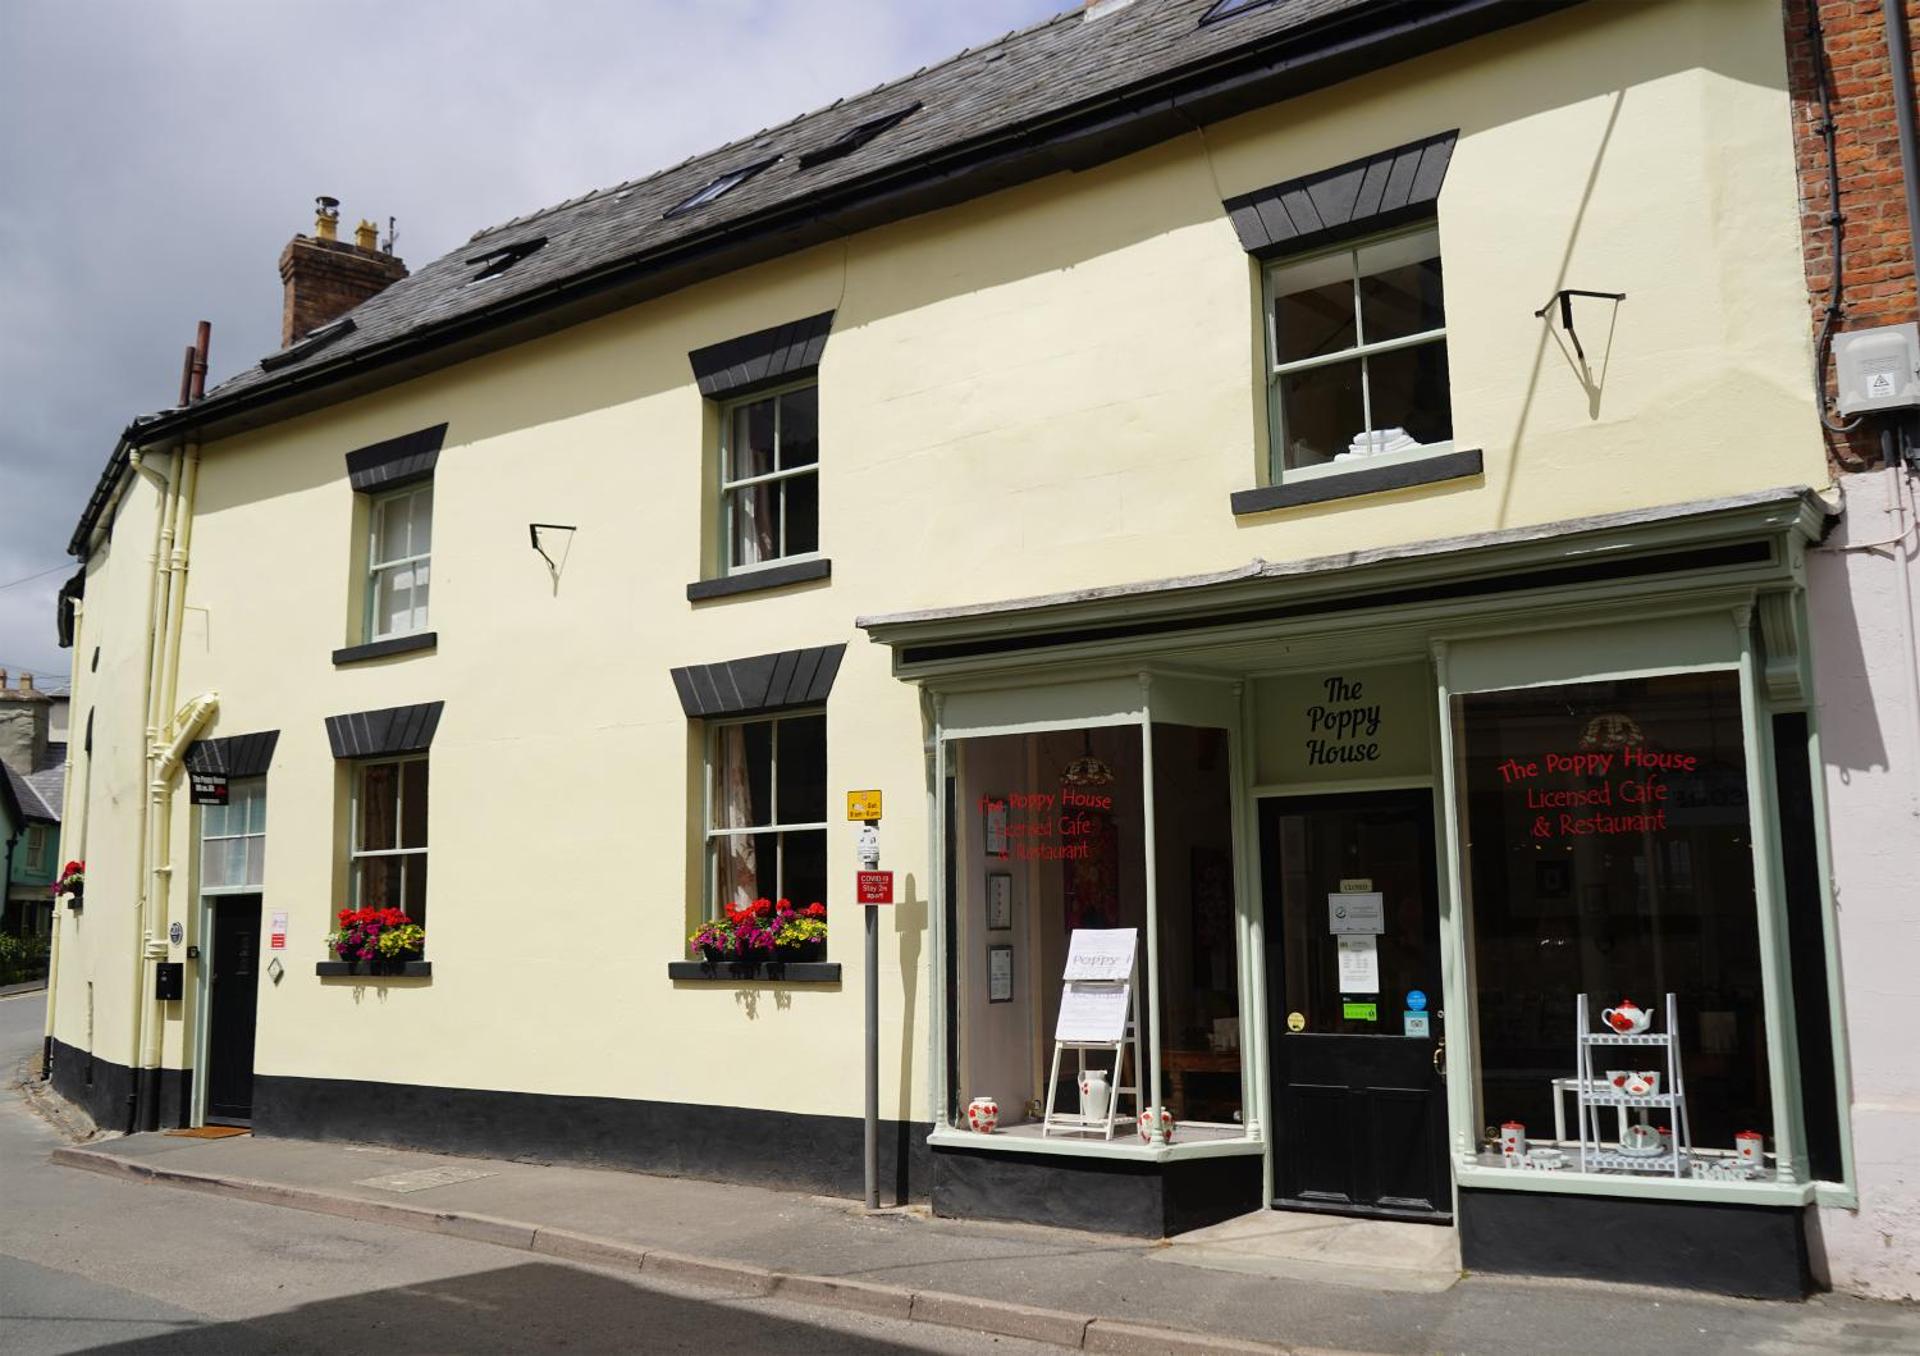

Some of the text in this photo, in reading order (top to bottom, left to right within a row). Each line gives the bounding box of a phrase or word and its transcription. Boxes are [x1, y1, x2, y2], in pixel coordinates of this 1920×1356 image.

[1324, 677, 1362, 702] The
[1307, 705, 1381, 739] Poppy
[1306, 740, 1380, 765] House
[1498, 746, 1697, 783] The Poppy House
[1008, 792, 1055, 810] Poppy
[1062, 788, 1112, 809] House
[1527, 781, 1612, 808] Licensed
[1619, 774, 1669, 803] Cafe
[1058, 812, 1091, 835] Cafe
[1532, 809, 1667, 838] & Restaurant
[1016, 840, 1088, 862] Restaurant
[862, 885, 877, 893] Stay
